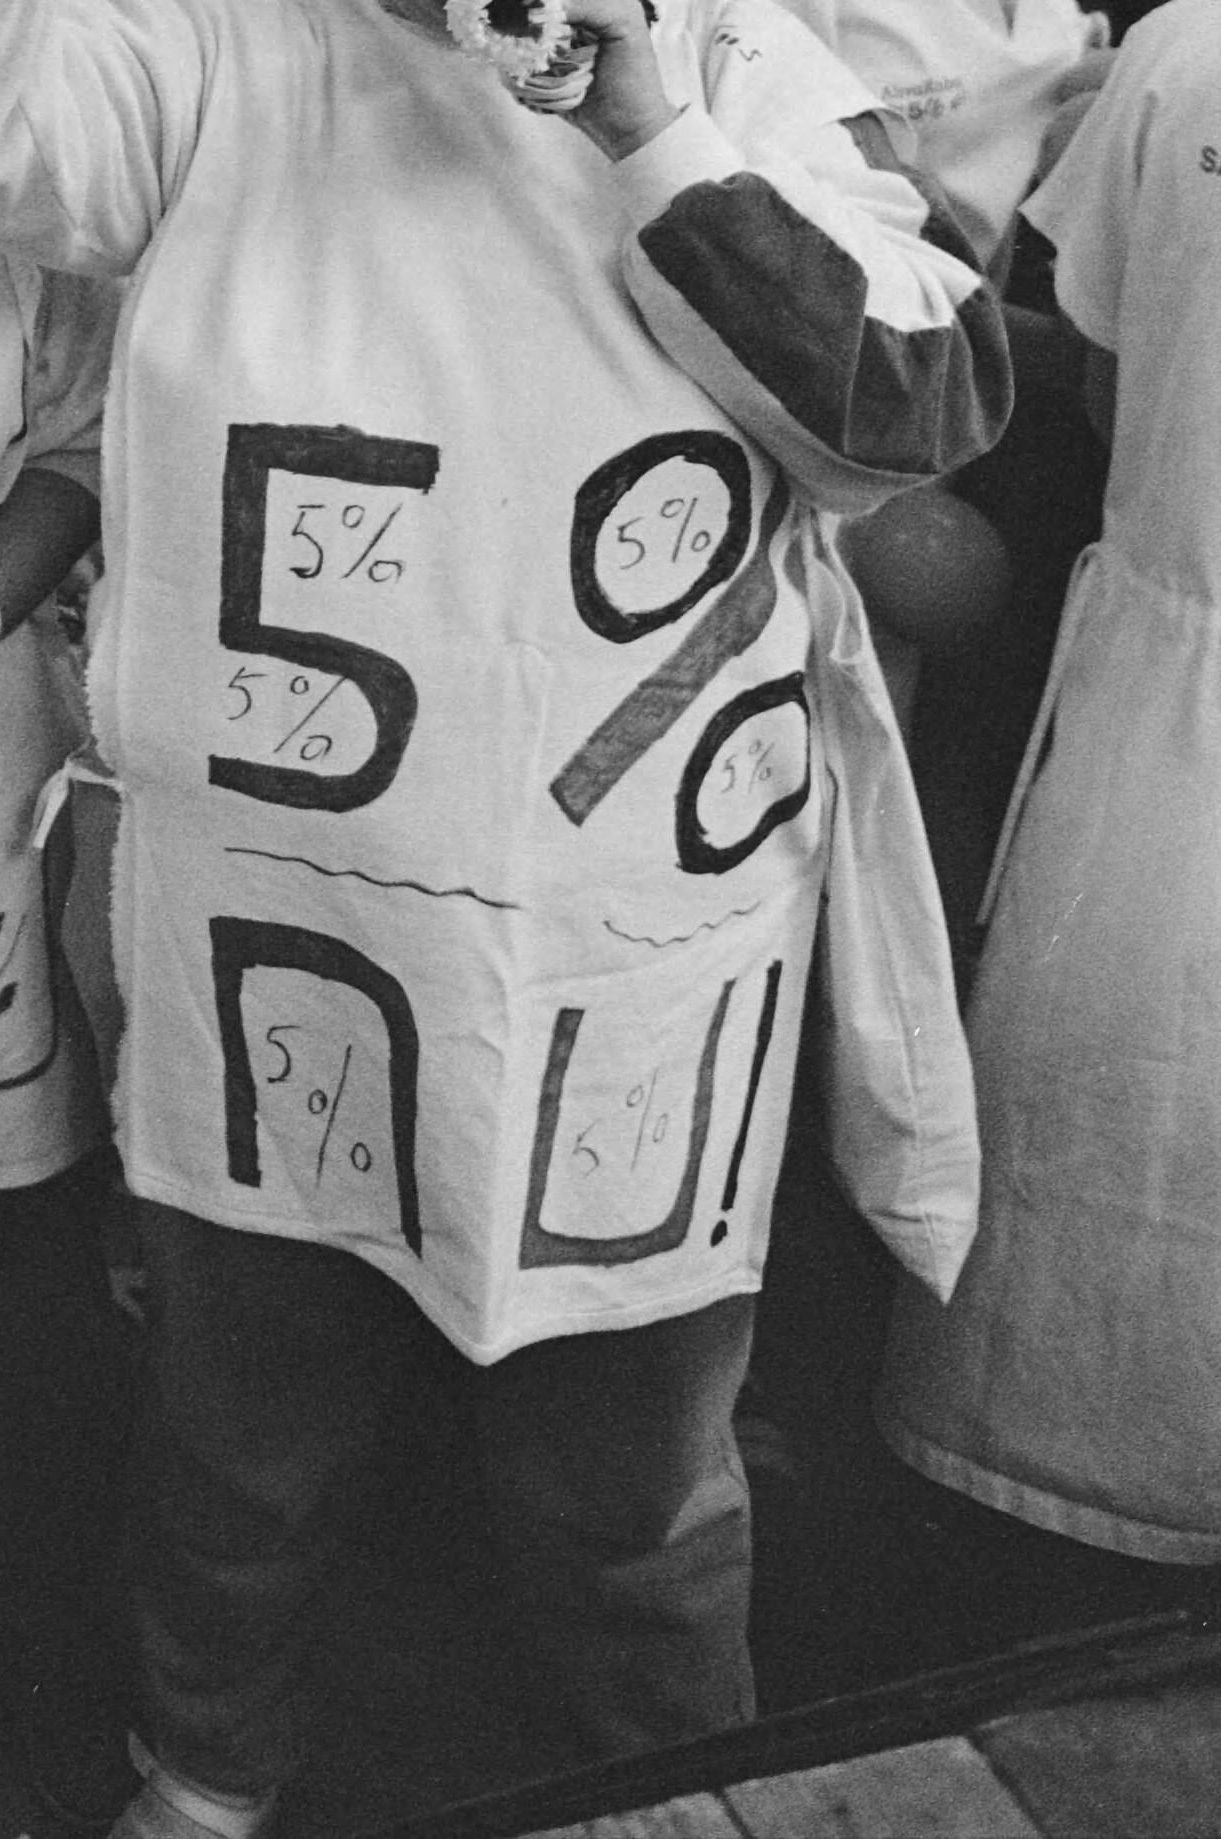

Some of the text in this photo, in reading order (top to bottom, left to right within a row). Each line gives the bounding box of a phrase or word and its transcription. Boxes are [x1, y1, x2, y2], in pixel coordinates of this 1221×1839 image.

[290, 502, 406, 584] 5%
[616, 496, 712, 571] 5%
[225, 668, 352, 763] 5%
[266, 1025, 373, 1189] 5%
